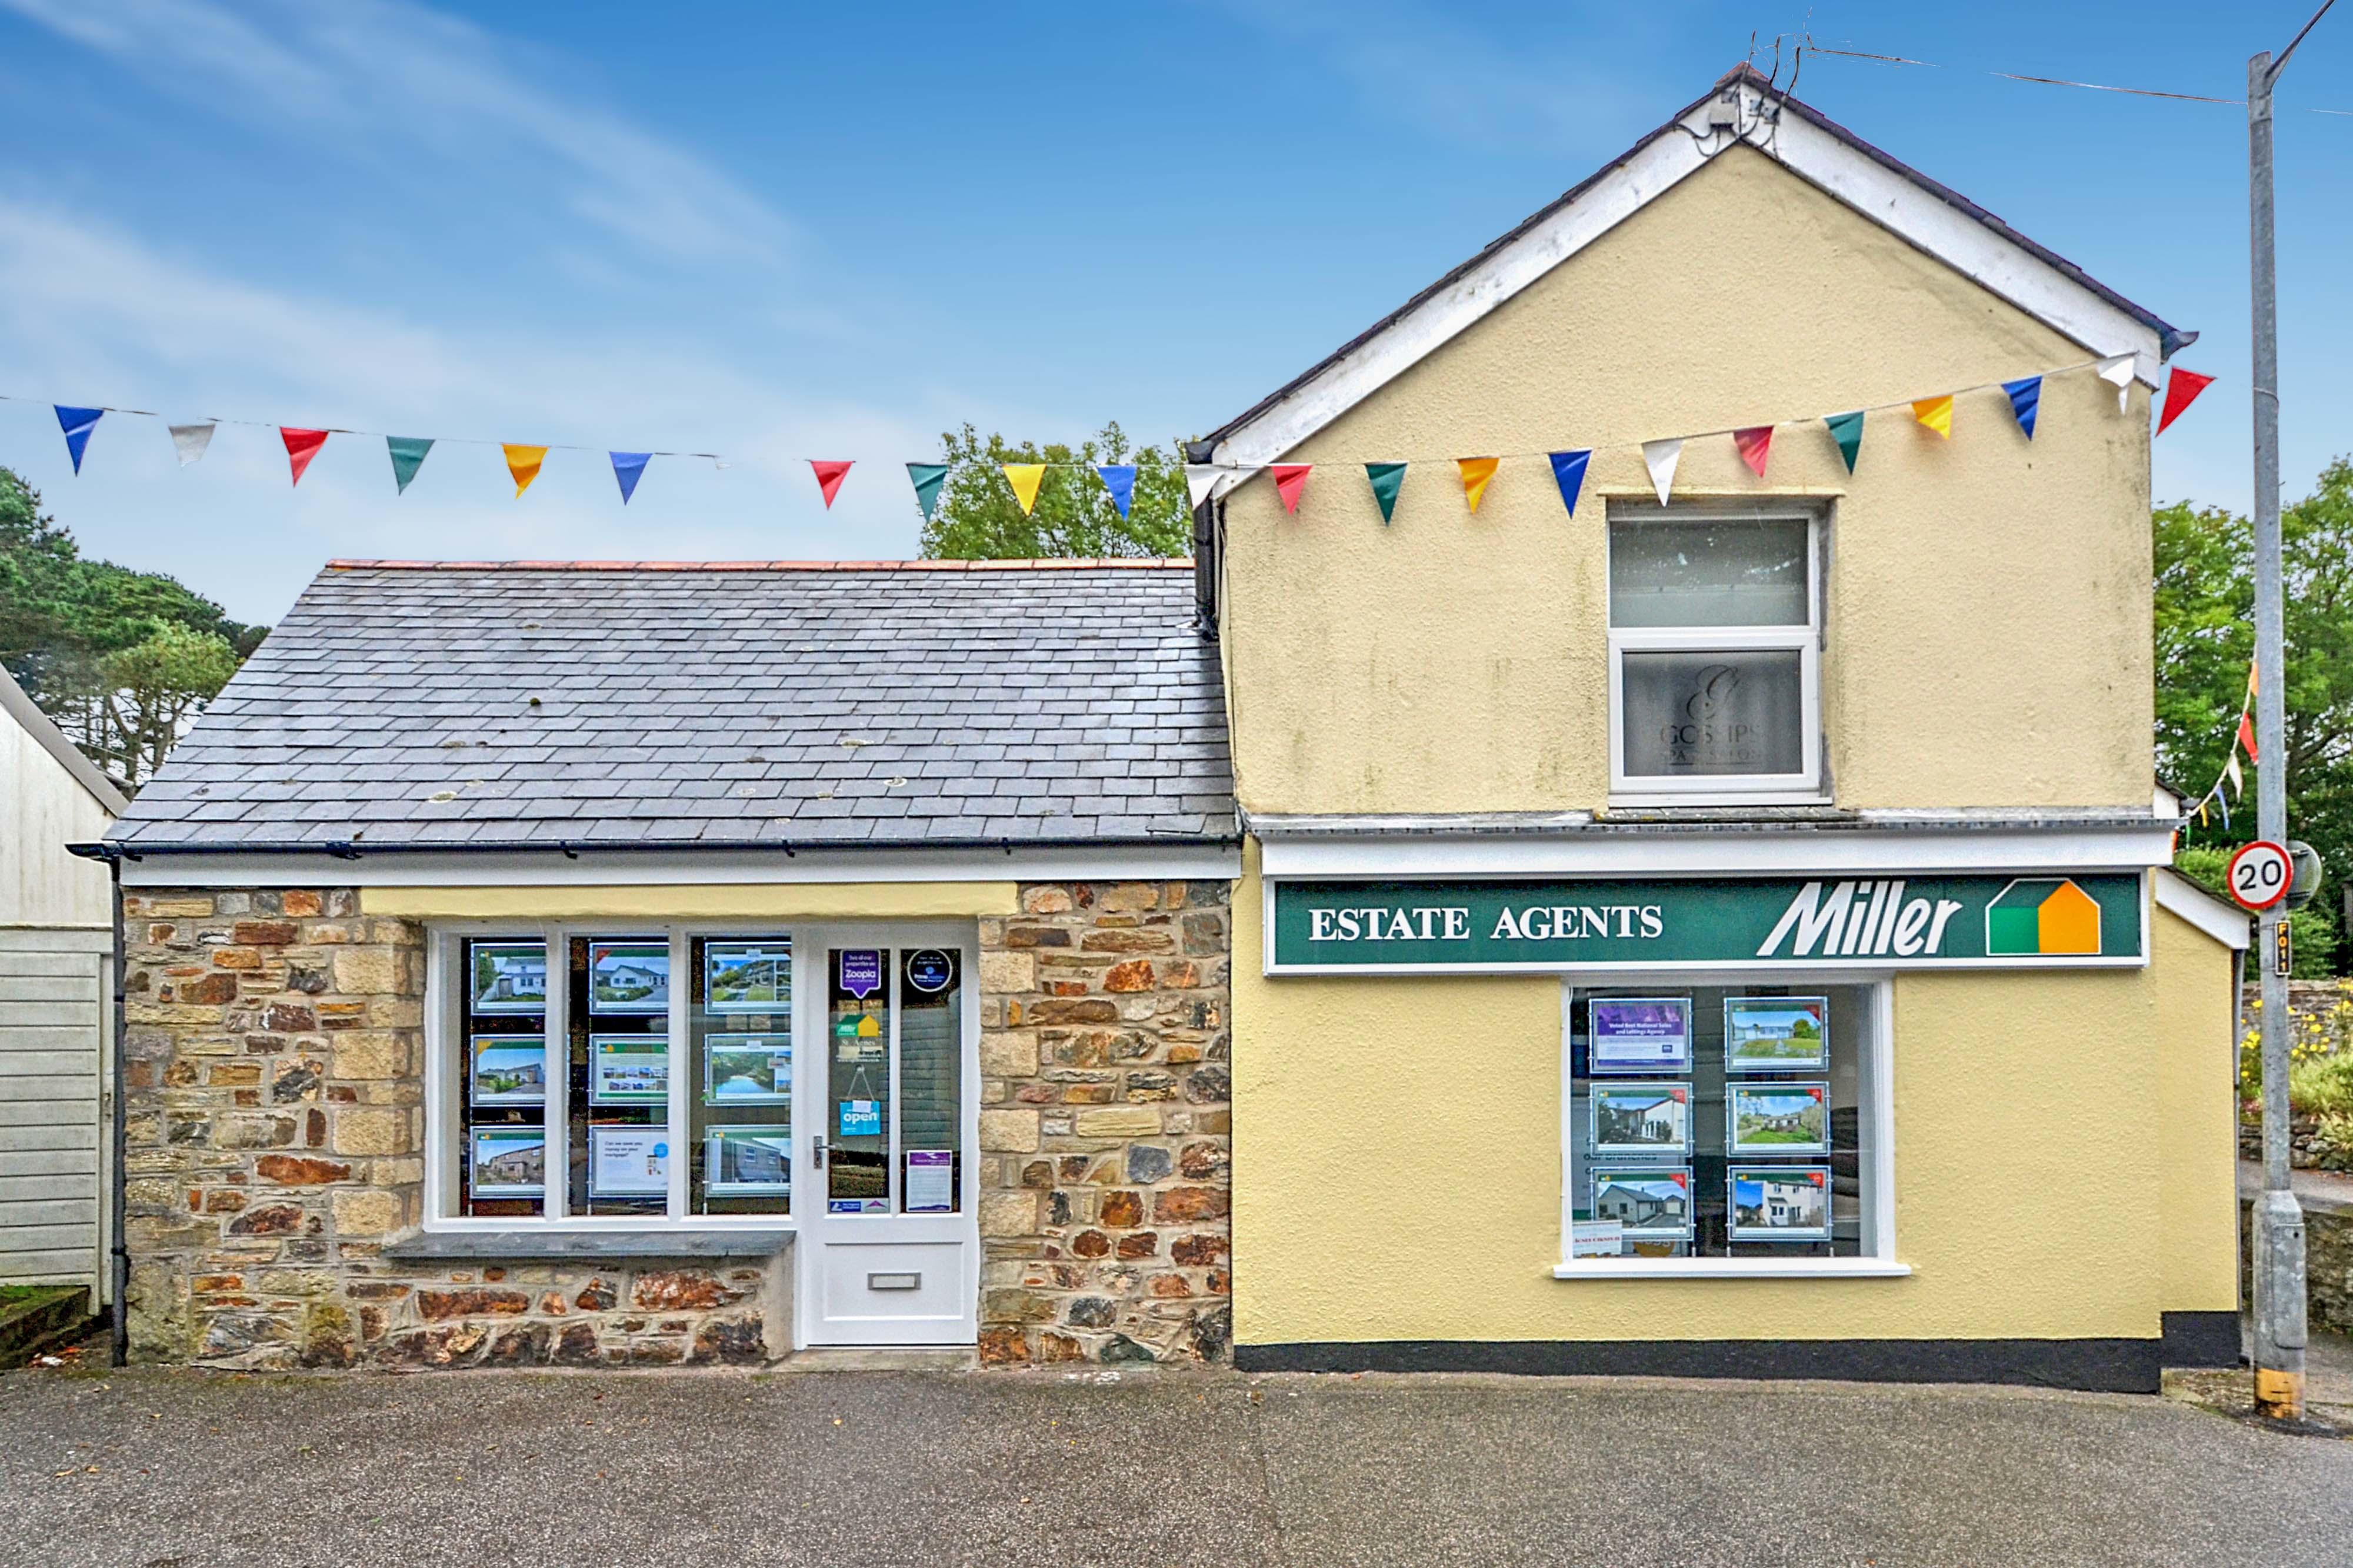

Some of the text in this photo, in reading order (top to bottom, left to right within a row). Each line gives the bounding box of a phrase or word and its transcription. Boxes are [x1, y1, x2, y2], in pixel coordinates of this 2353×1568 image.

[2238, 859, 2281, 891] 20
[1309, 880, 1963, 956] ESTATE AGENTS Miller
[845, 969, 876, 979] Zoopla
[843, 1112, 877, 1125] open
